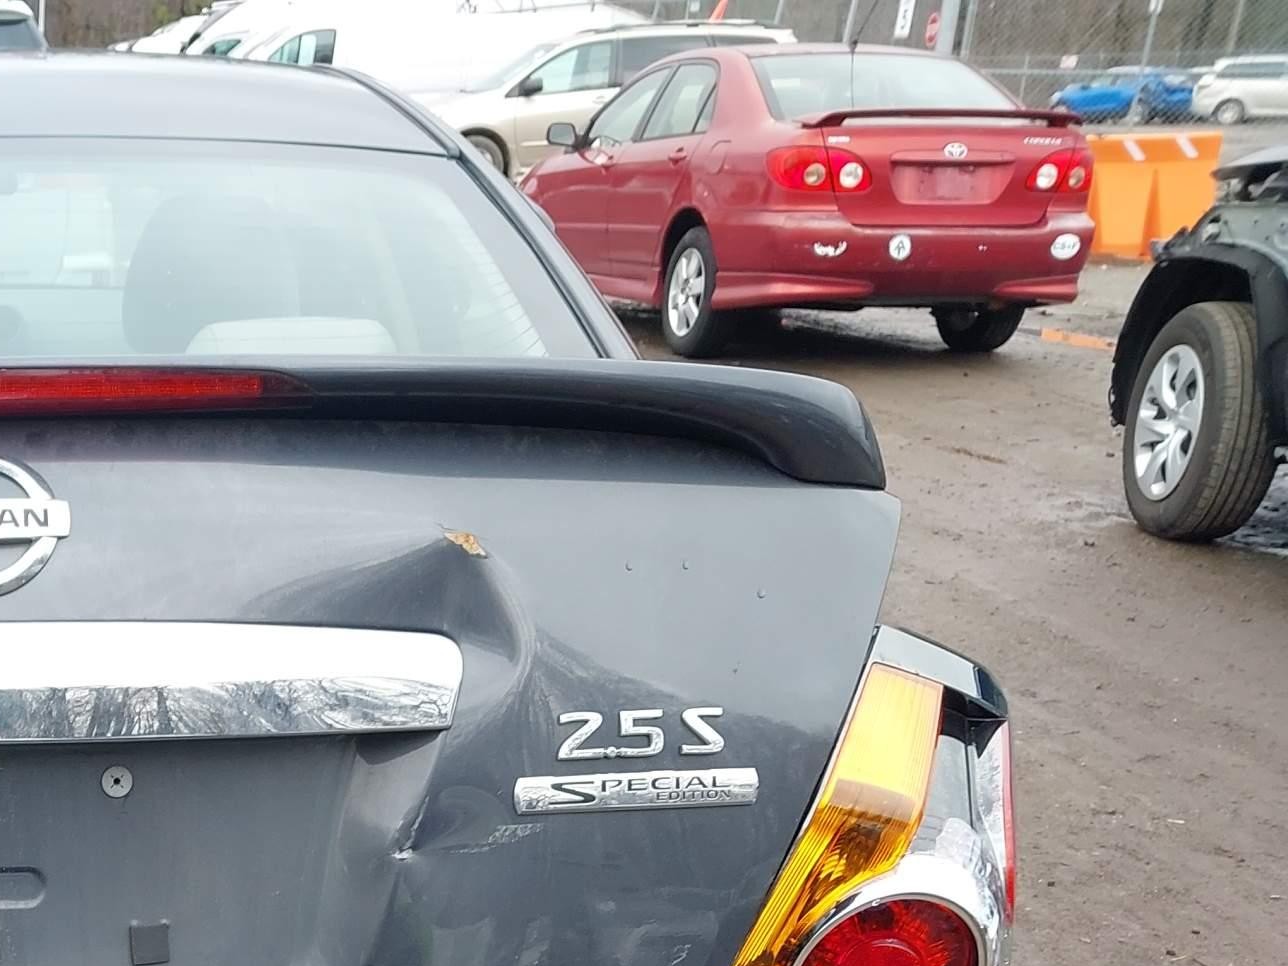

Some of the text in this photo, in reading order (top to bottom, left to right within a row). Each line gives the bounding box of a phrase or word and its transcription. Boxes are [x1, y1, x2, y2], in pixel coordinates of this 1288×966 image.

[557, 706, 725, 761] 2.5 S
[548, 776, 731, 805] SPECIAL
[656, 789, 731, 802] EDITION
